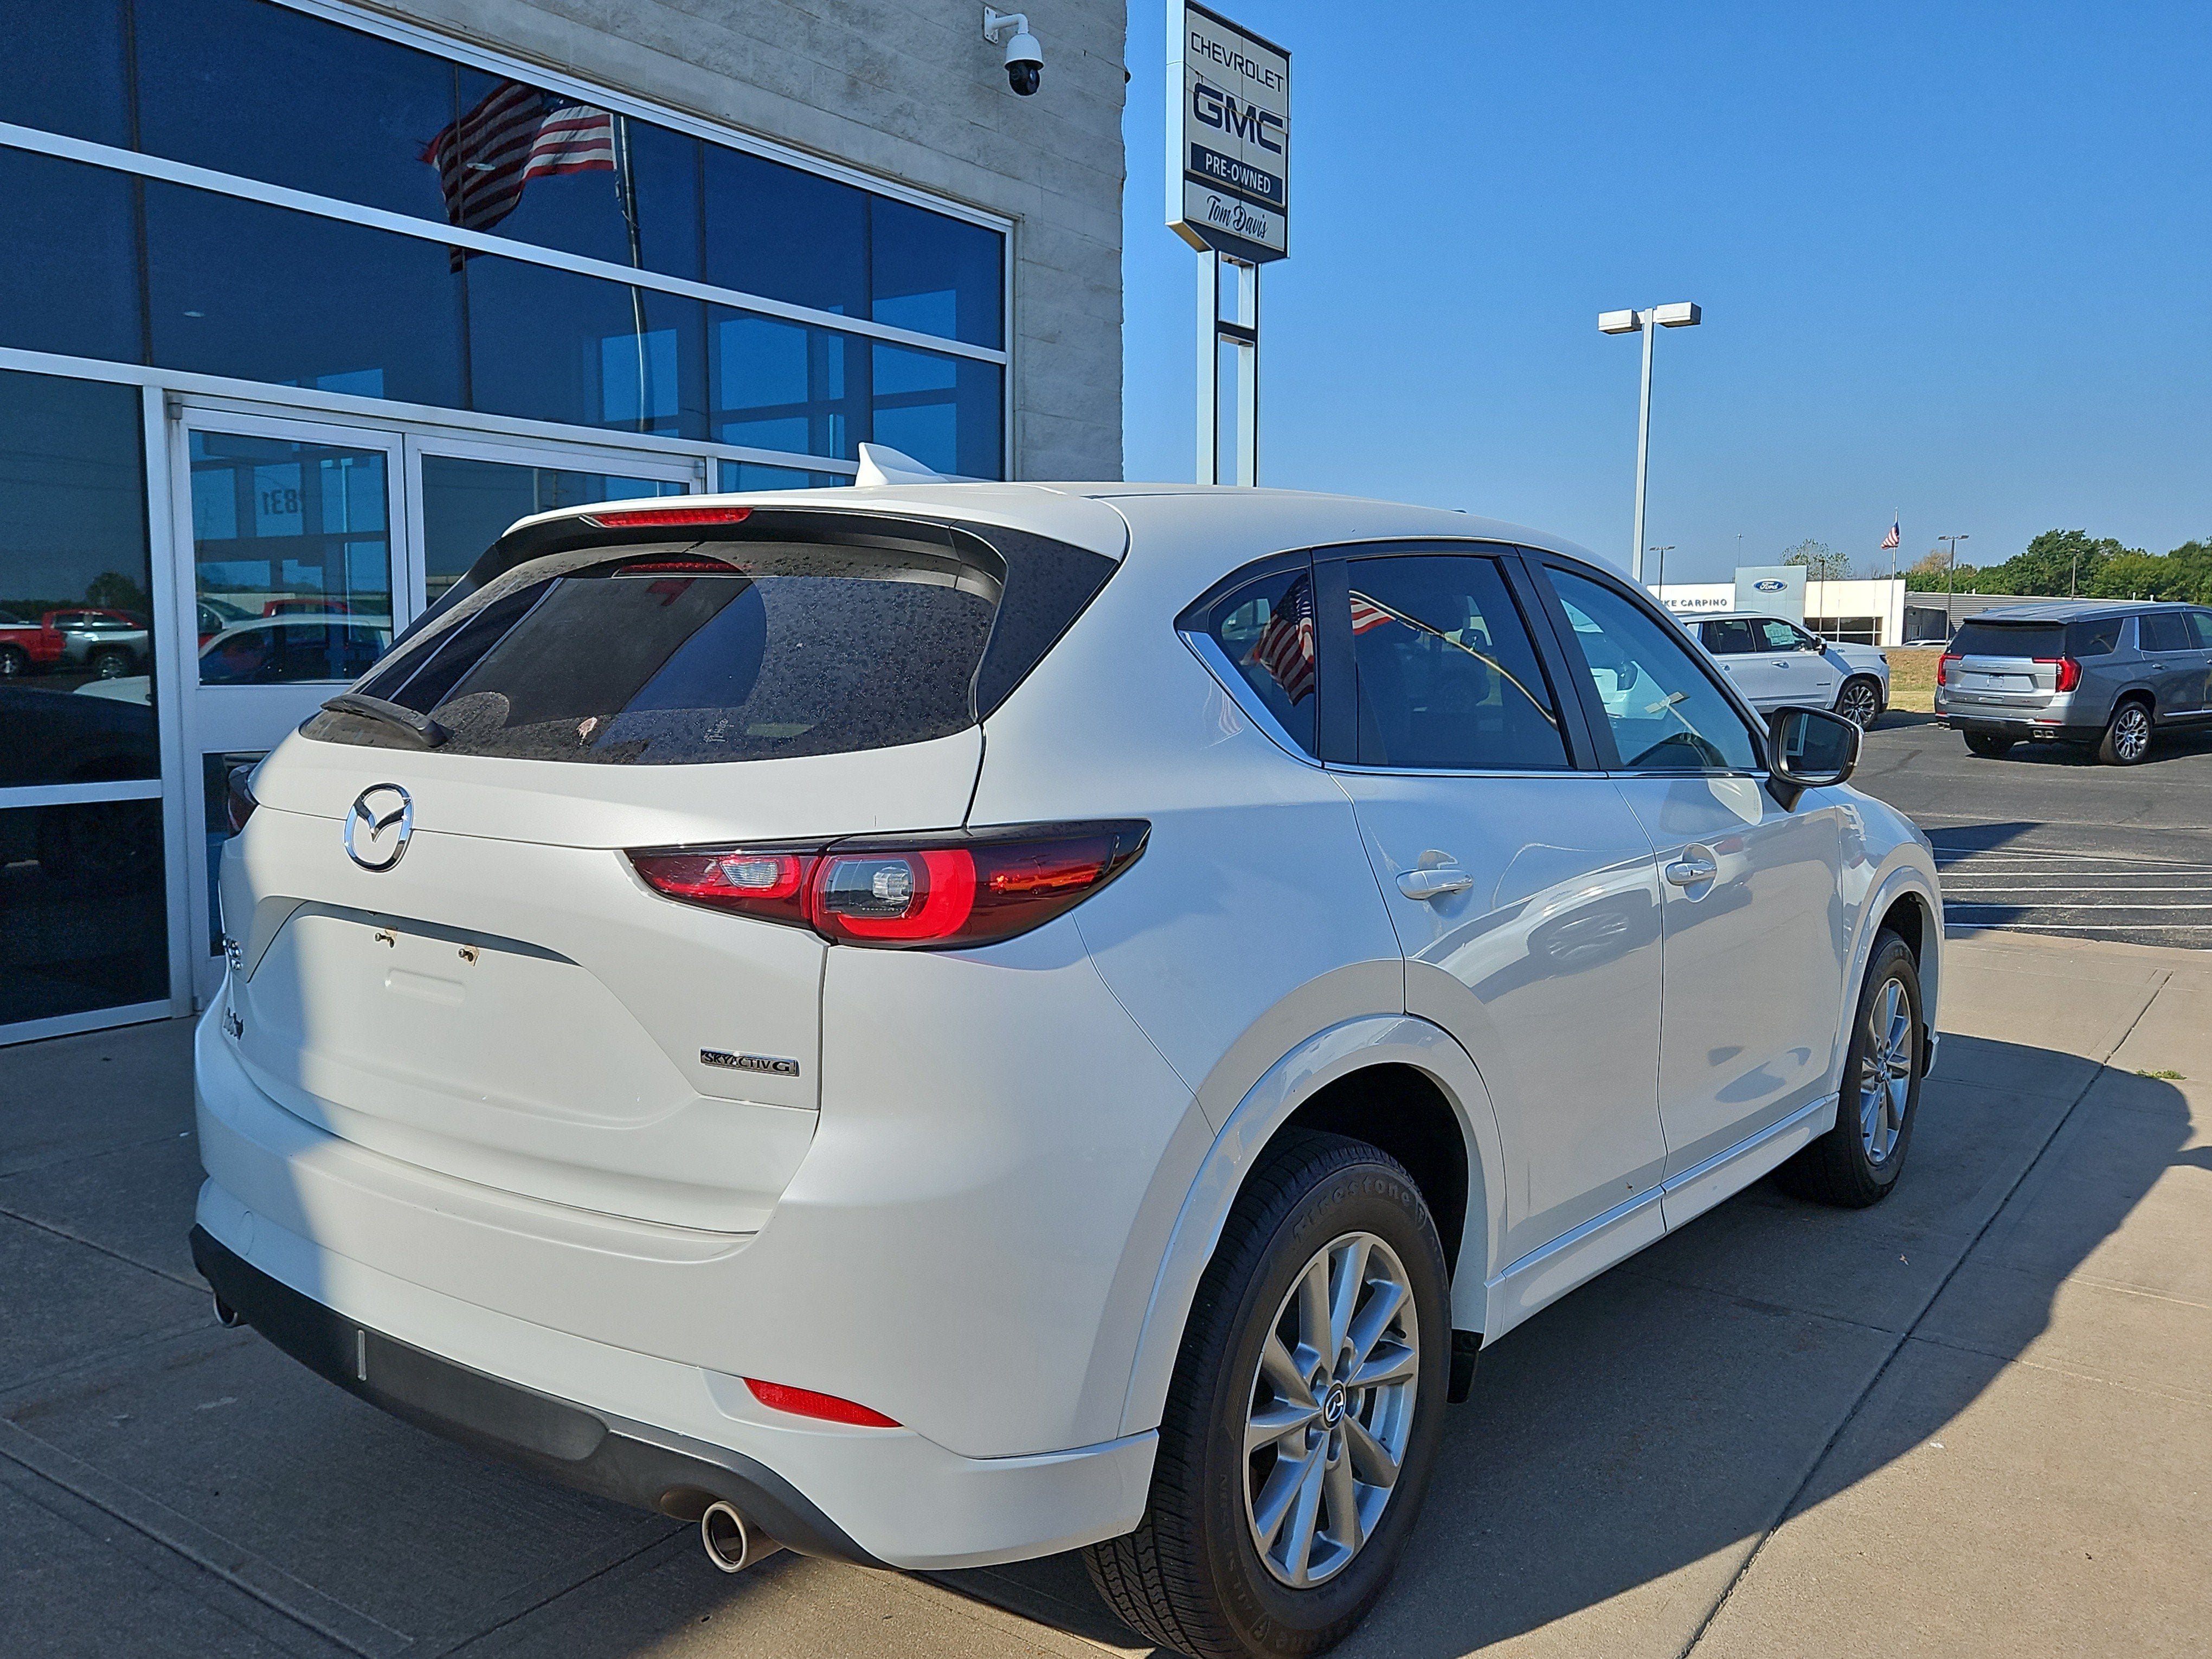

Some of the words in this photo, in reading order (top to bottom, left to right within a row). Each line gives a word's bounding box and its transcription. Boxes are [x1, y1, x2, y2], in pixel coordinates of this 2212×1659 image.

[1192, 32, 1283, 92] CHEVROLET
[1194, 82, 1282, 155] GMC
[1206, 153, 1270, 194] PRE-OWNED
[1207, 195, 1231, 222] Tom
[1232, 205, 1268, 239] Davis
[1681, 599, 1727, 607] CARPINO
